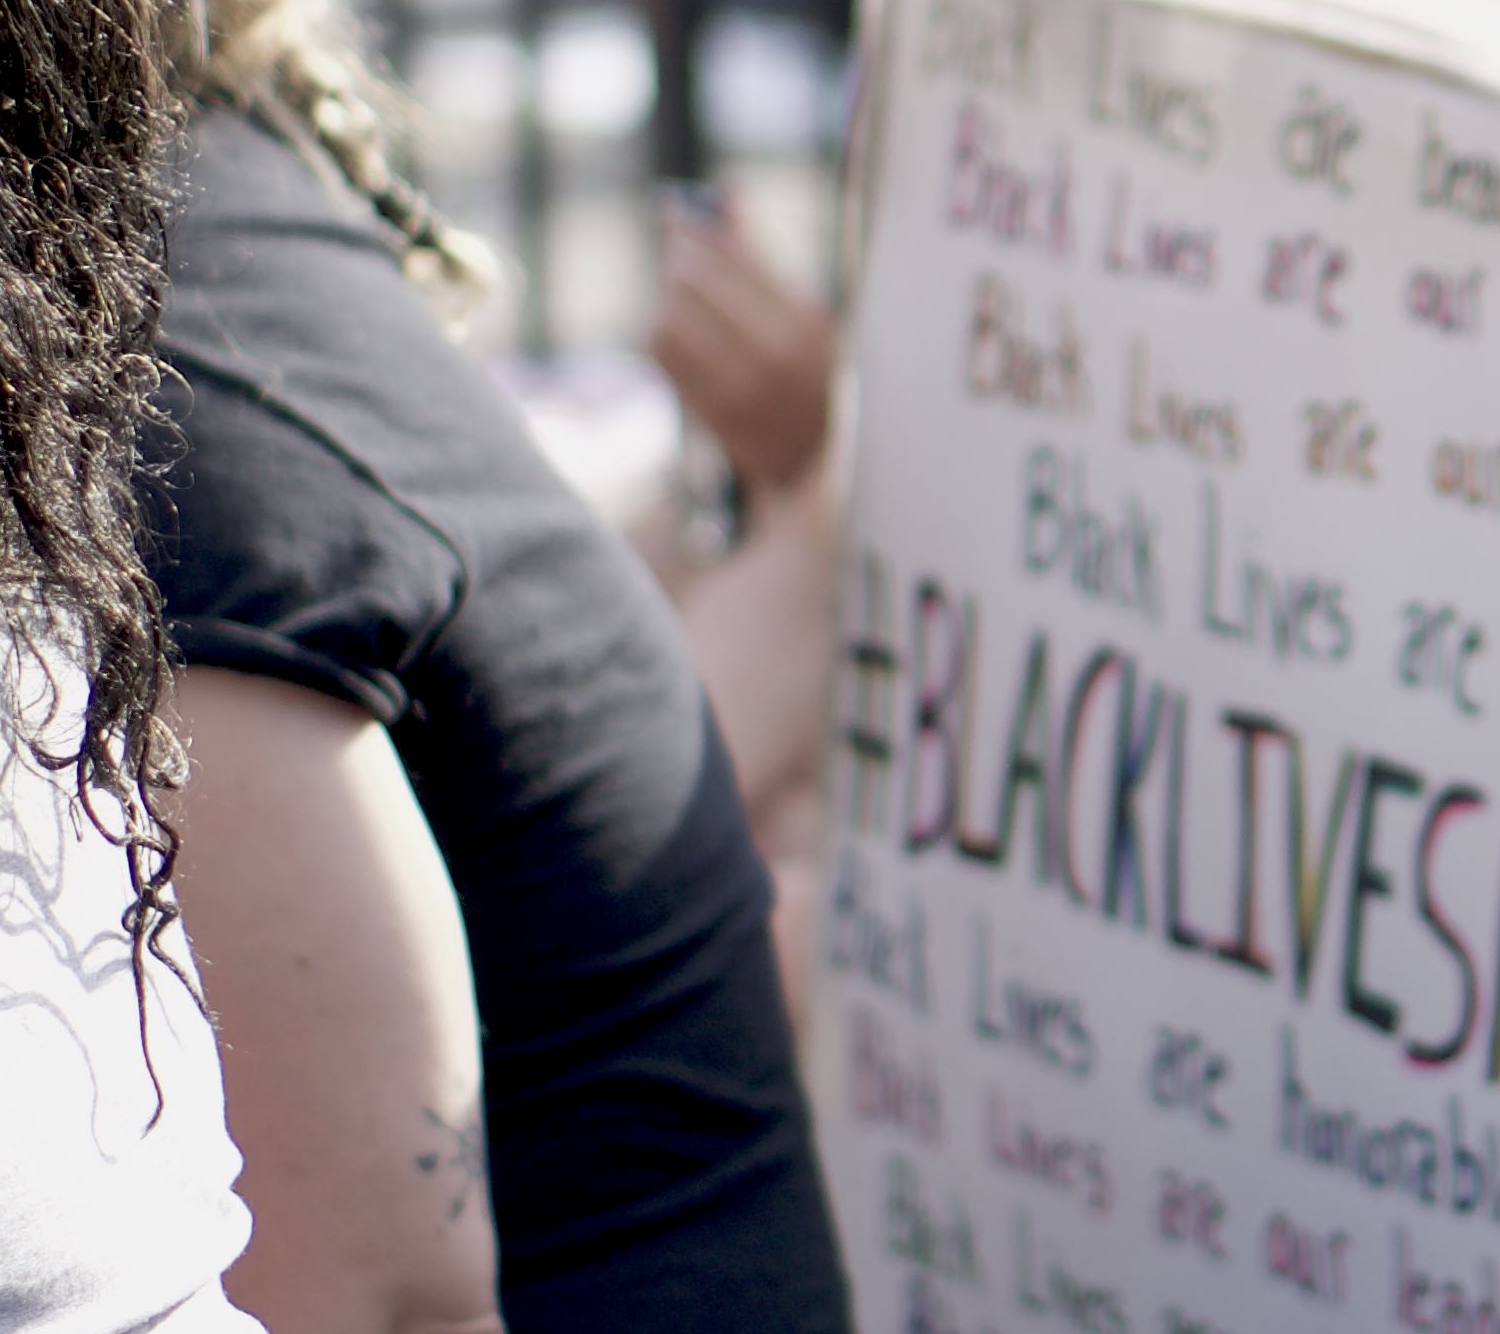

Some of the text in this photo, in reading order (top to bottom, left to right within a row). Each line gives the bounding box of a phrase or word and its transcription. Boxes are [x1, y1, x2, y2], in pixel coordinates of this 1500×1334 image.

[950, 96, 1069, 253] Black
[1107, 173, 1214, 288] Lives
[1262, 232, 1346, 325] are
[1408, 267, 1482, 338] our
[1278, 82, 1362, 196] are
[966, 270, 1088, 412] Black
[1126, 338, 1242, 461] Lives
[1306, 401, 1376, 480] are
[1025, 445, 1160, 623] Black
[1206, 478, 1351, 656] Lives
[1400, 601, 1482, 714] are
[975, 914, 1091, 1080] Lives
[1153, 1027, 1226, 1127] are
[988, 1084, 1111, 1211] Lives
[1160, 1172, 1224, 1258] are
[1269, 1215, 1346, 1303] our
